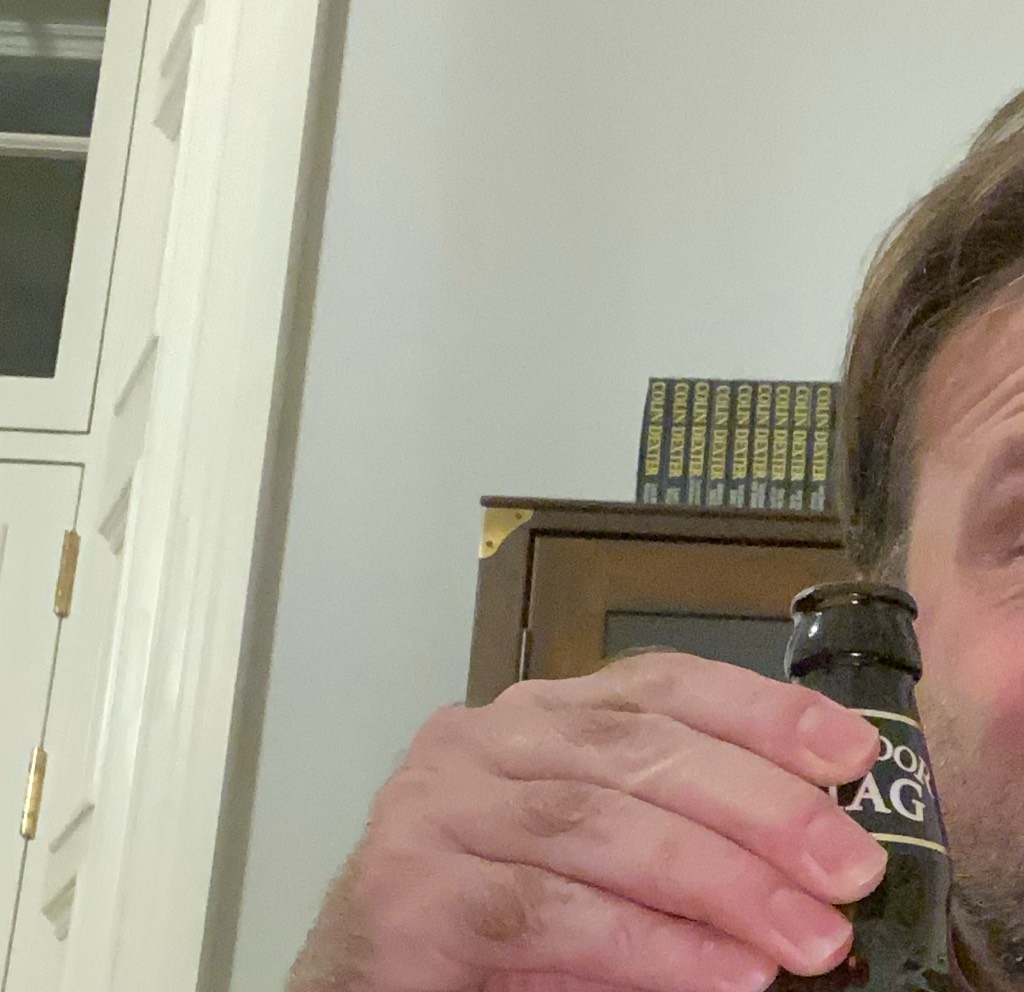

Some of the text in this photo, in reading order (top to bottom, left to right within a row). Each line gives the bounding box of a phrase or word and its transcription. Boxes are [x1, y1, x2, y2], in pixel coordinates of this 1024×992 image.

[650, 381, 666, 426] COLIN
[672, 382, 689, 423] COLIN
[692, 381, 709, 423] COLIN
[715, 385, 730, 425] COLIN
[736, 384, 752, 425] COLIN
[756, 384, 772, 425] COLIN
[775, 385, 791, 426] COLIN
[793, 385, 810, 427] COLIN
[815, 387, 831, 428] COLIN
[645, 425, 663, 476] DEXTER
[668, 426, 686, 477] DEXTER
[689, 424, 707, 476] DEXTER
[710, 429, 729, 480] DEXTER
[732, 428, 749, 480] DEXTER
[752, 428, 769, 479] DEXTER
[771, 429, 788, 480] DEXTER
[791, 430, 807, 481] DEXTER
[812, 431, 829, 481] DEXTER
[879, 735, 935, 800] OOR
[829, 771, 926, 822] AG
